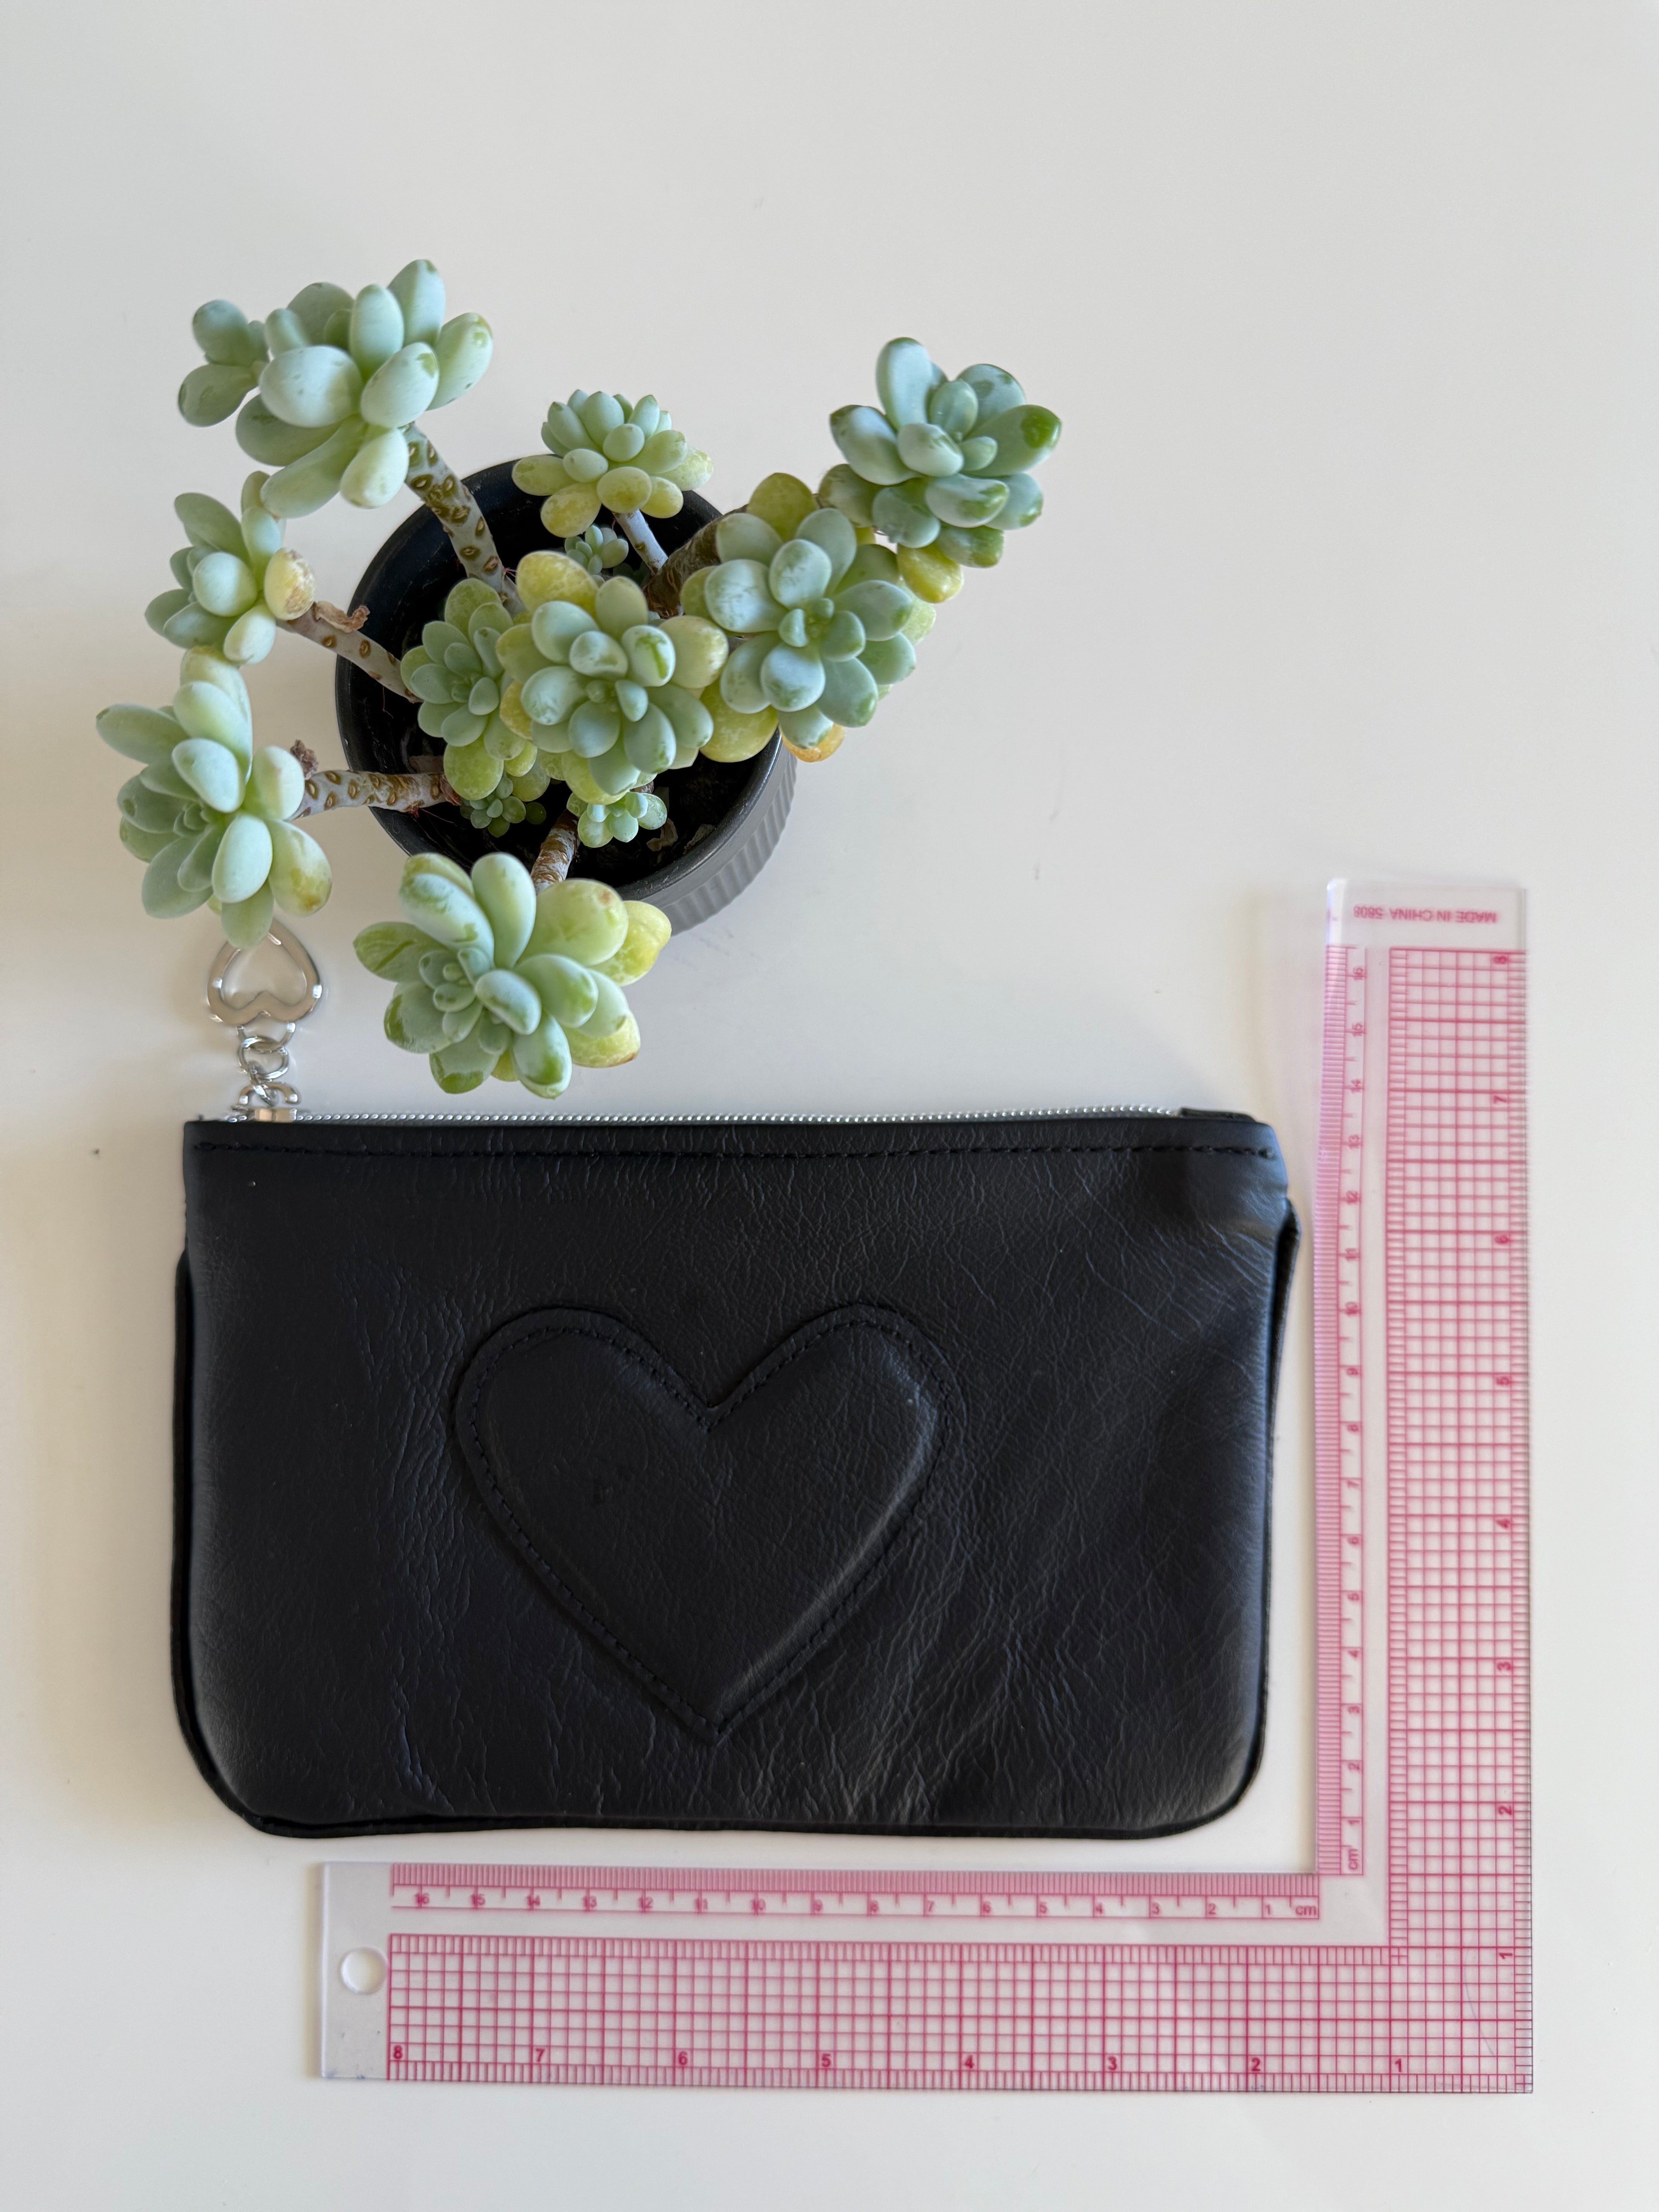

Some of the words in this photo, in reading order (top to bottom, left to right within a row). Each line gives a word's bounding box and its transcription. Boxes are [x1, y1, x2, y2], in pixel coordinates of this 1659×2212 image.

[1389, 908, 1431, 922] CHINA
[1437, 910, 1450, 922] IN
[1456, 911, 1497, 923] MADE
[1494, 956, 1509, 965] 8
[1353, 967, 1363, 981] 16
[1352, 1022, 1363, 1037] 15
[1351, 1079, 1362, 1093] 14
[1348, 1135, 1360, 1149] 13
[1347, 1191, 1358, 1205] 12
[1346, 1248, 1357, 1261] 11
[1346, 1302, 1358, 1315] 10
[1496, 1376, 1510, 1386] 5
[1346, 1480, 1358, 1488] 7
[1496, 1518, 1510, 1528] 4
[1348, 1536, 1359, 1545] 6
[1497, 1661, 1511, 1671] 3
[1348, 1763, 1360, 1771] 2
[1498, 1805, 1512, 1815] 2
[1348, 1849, 1358, 1870] cm
[415, 1893, 429, 1905] 16
[471, 1894, 485, 1905] 15
[527, 1894, 540, 1906] 14
[583, 1896, 597, 1908] 13
[639, 1897, 653, 1910] 12
[694, 1898, 708, 1911] 11
[751, 1899, 766, 1911] 10
[928, 1901, 935, 1912] 7
[982, 1901, 991, 1913] 6
[1039, 1901, 1048, 1914] 5
[1096, 1902, 1104, 1914] 4
[1152, 1903, 1160, 1915] 3
[1207, 1903, 1216, 1915] 2
[1266, 1904, 1271, 1915] 1
[1295, 1906, 1317, 1916] cm
[393, 2045, 403, 2060] 8
[536, 2048, 545, 2062] 7
[678, 2051, 688, 2065] 6
[821, 2053, 831, 2067] 5
[965, 2054, 974, 2069] 4
[1108, 2056, 1117, 2071] 3
[1251, 2057, 1261, 2073] 2
[1395, 2058, 1403, 2073] 1
